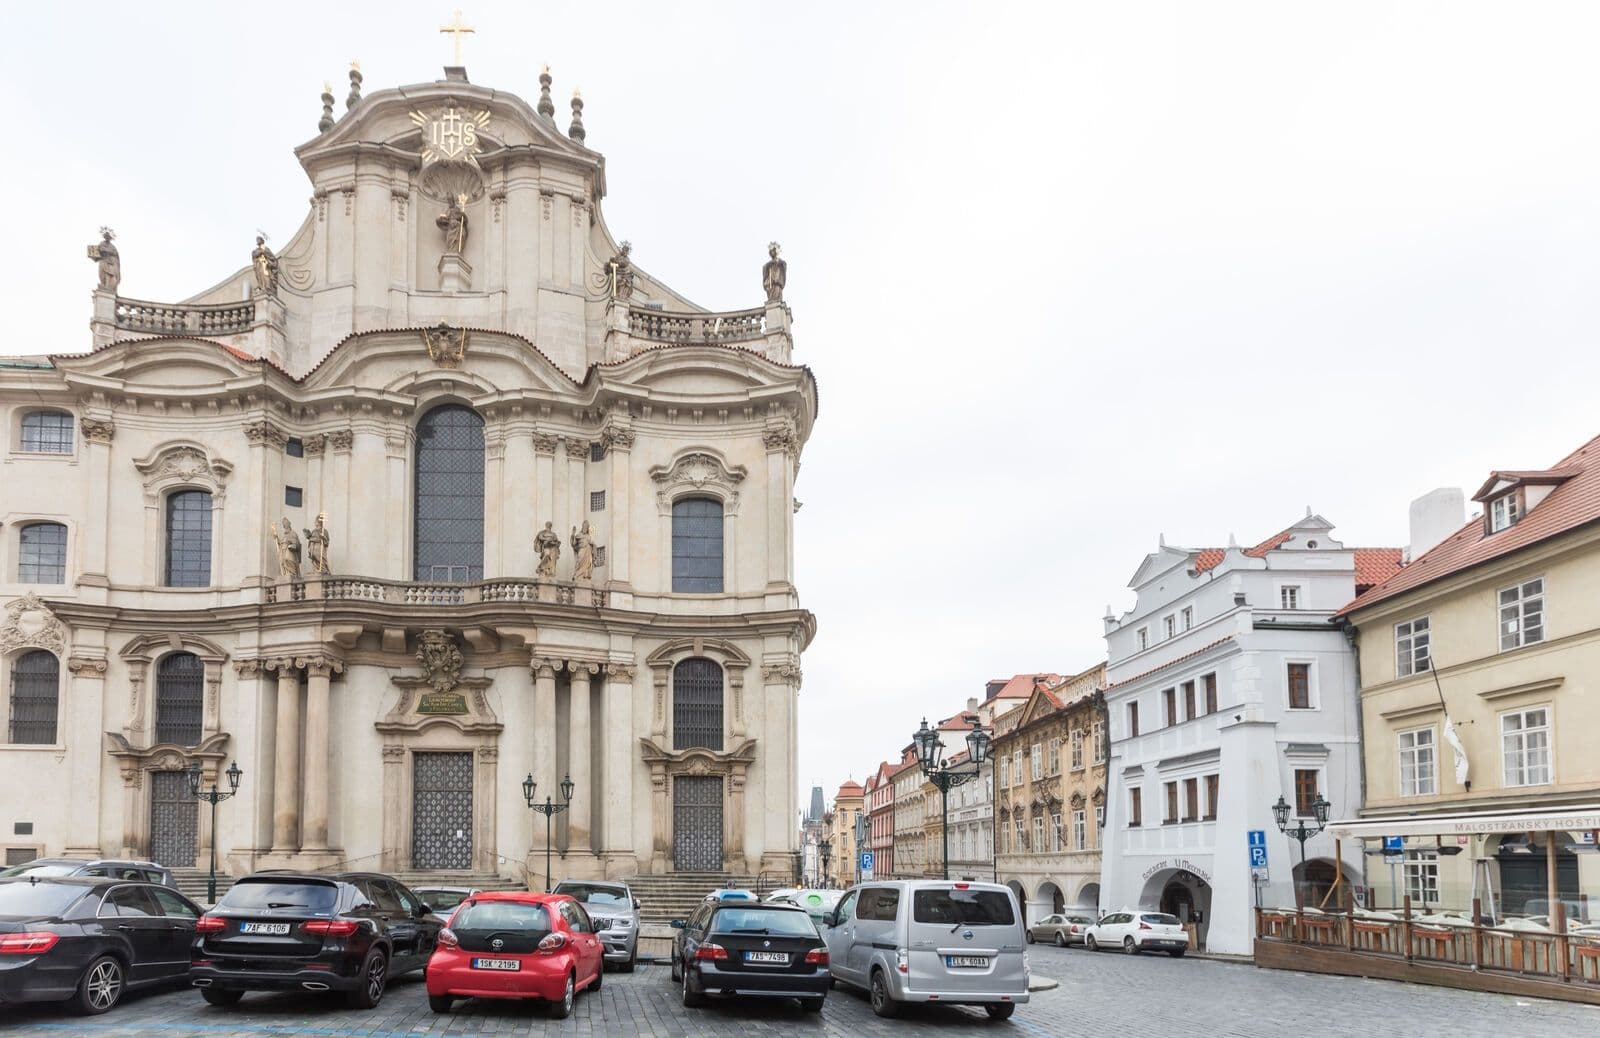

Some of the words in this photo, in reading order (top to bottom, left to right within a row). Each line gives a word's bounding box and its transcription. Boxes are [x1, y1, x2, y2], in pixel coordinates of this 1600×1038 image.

[432, 120, 476, 147] IHS
[863, 854, 871, 865] P
[1252, 848, 1264, 861] P
[480, 959, 493, 968] 1SK
[498, 960, 516, 969] 2195
